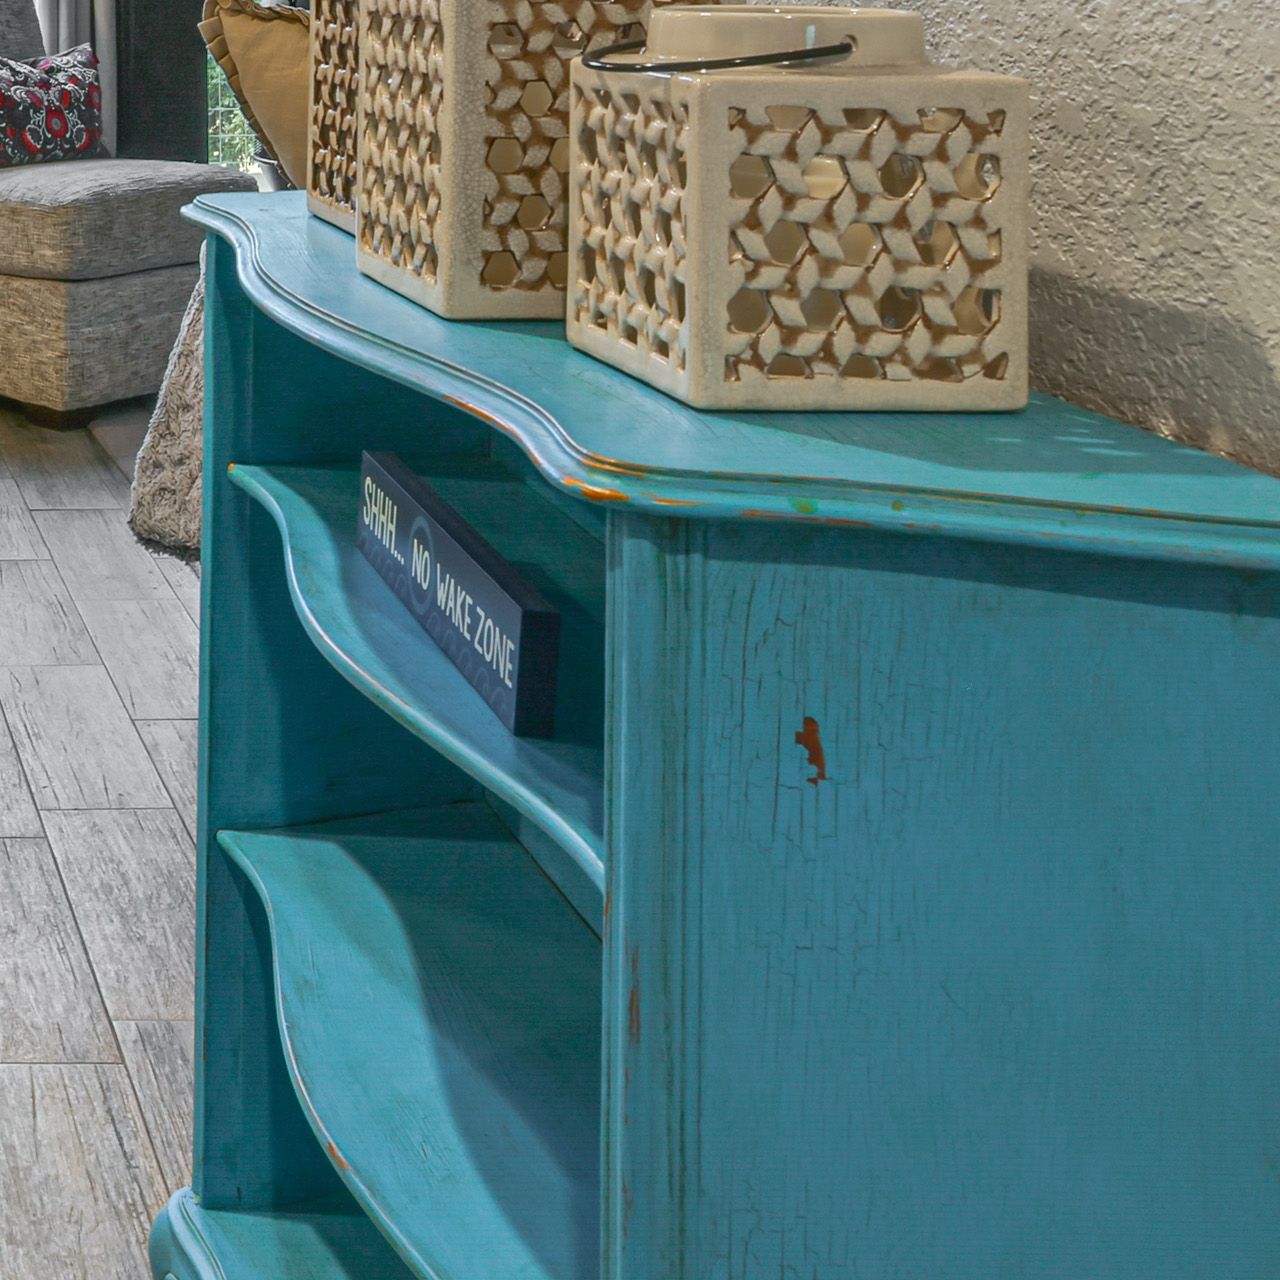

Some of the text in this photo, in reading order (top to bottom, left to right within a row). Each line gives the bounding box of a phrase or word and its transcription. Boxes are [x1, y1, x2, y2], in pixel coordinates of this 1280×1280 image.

[363, 476, 515, 689] SHHH... NO WAKE ZONE
